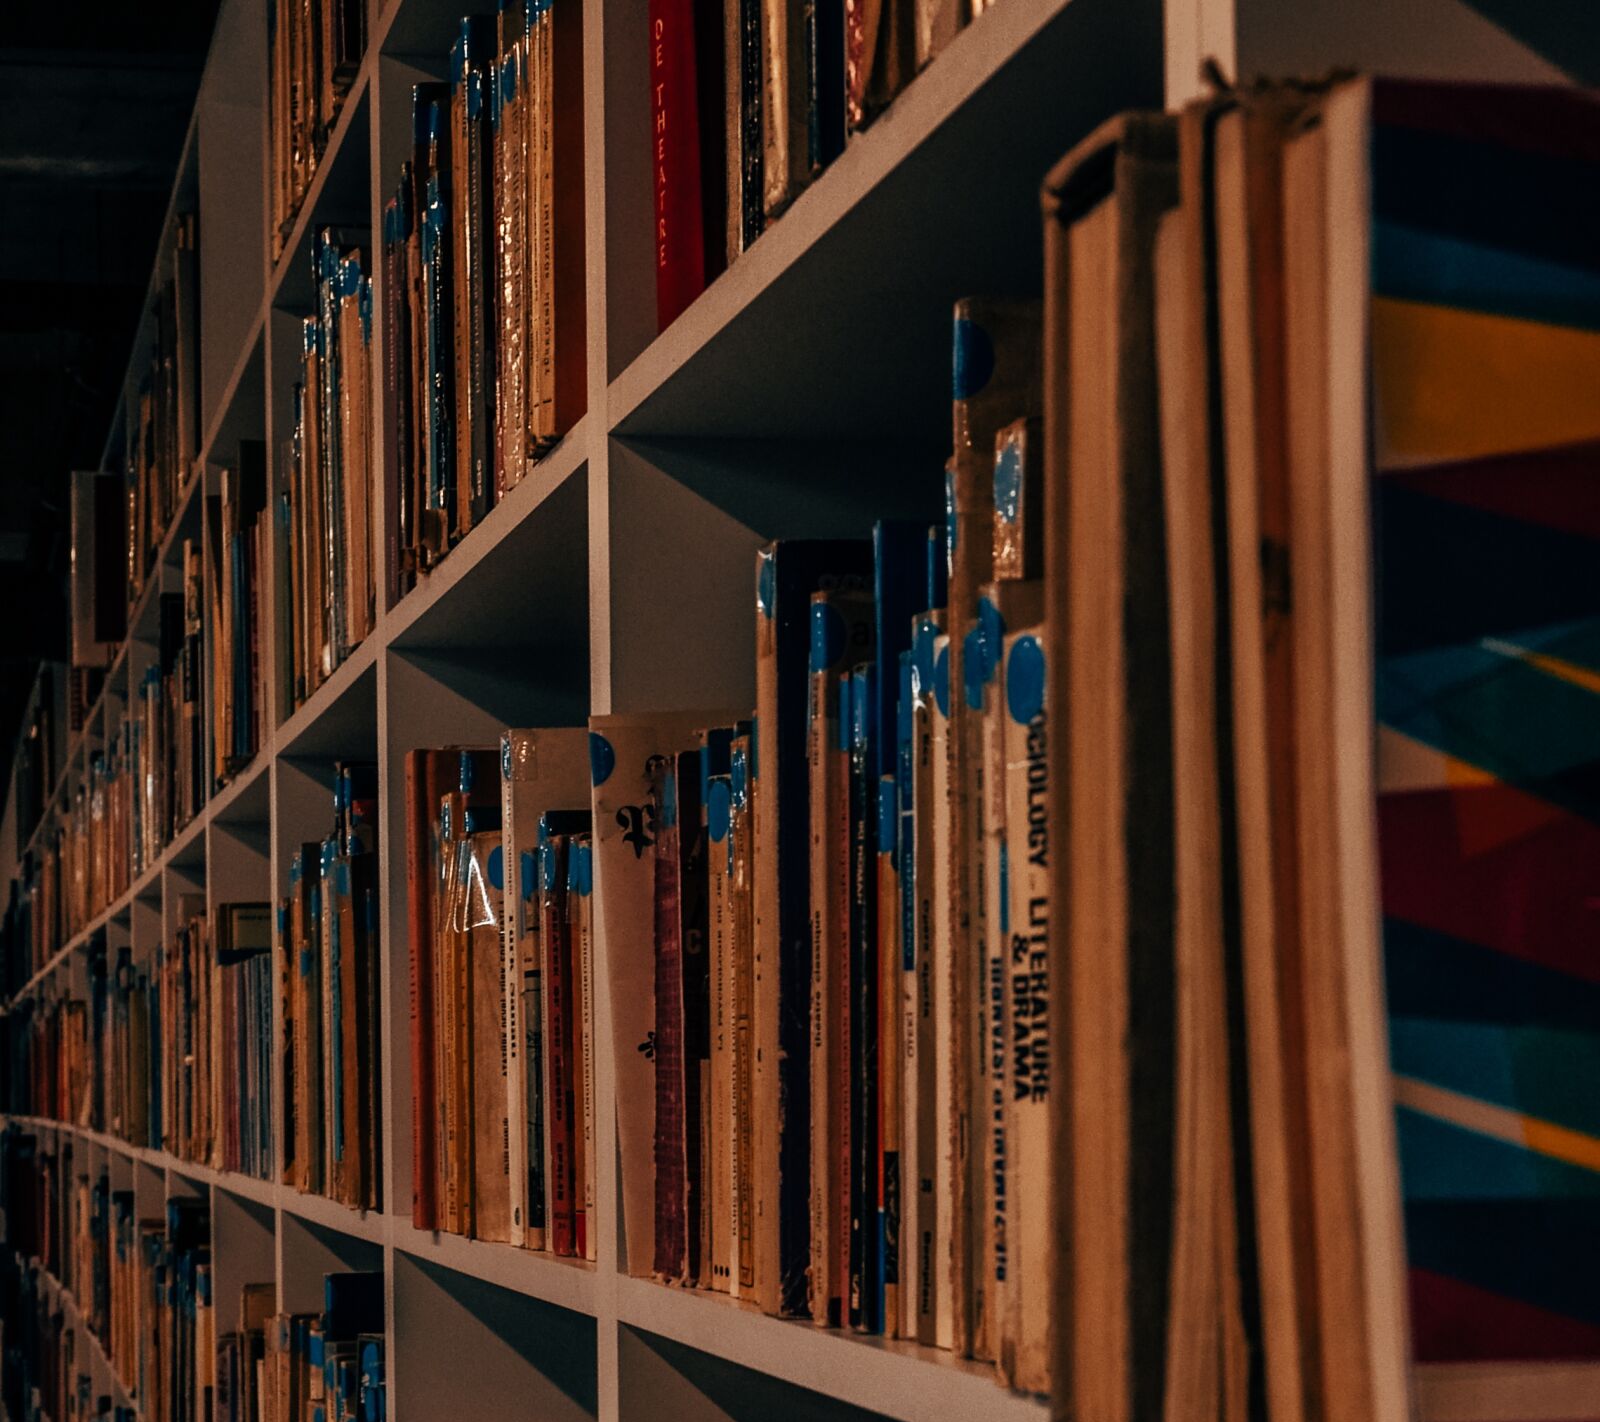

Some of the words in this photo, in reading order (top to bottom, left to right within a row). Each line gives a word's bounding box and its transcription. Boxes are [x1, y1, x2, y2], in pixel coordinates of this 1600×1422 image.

[715, 930, 724, 1027] PSYCHOLOGIE
[1012, 934, 1030, 965] &
[1012, 974, 1031, 1102] DRAMA
[1029, 897, 1050, 1104] LITERATURE
[921, 1230, 932, 1315] Bompiani
